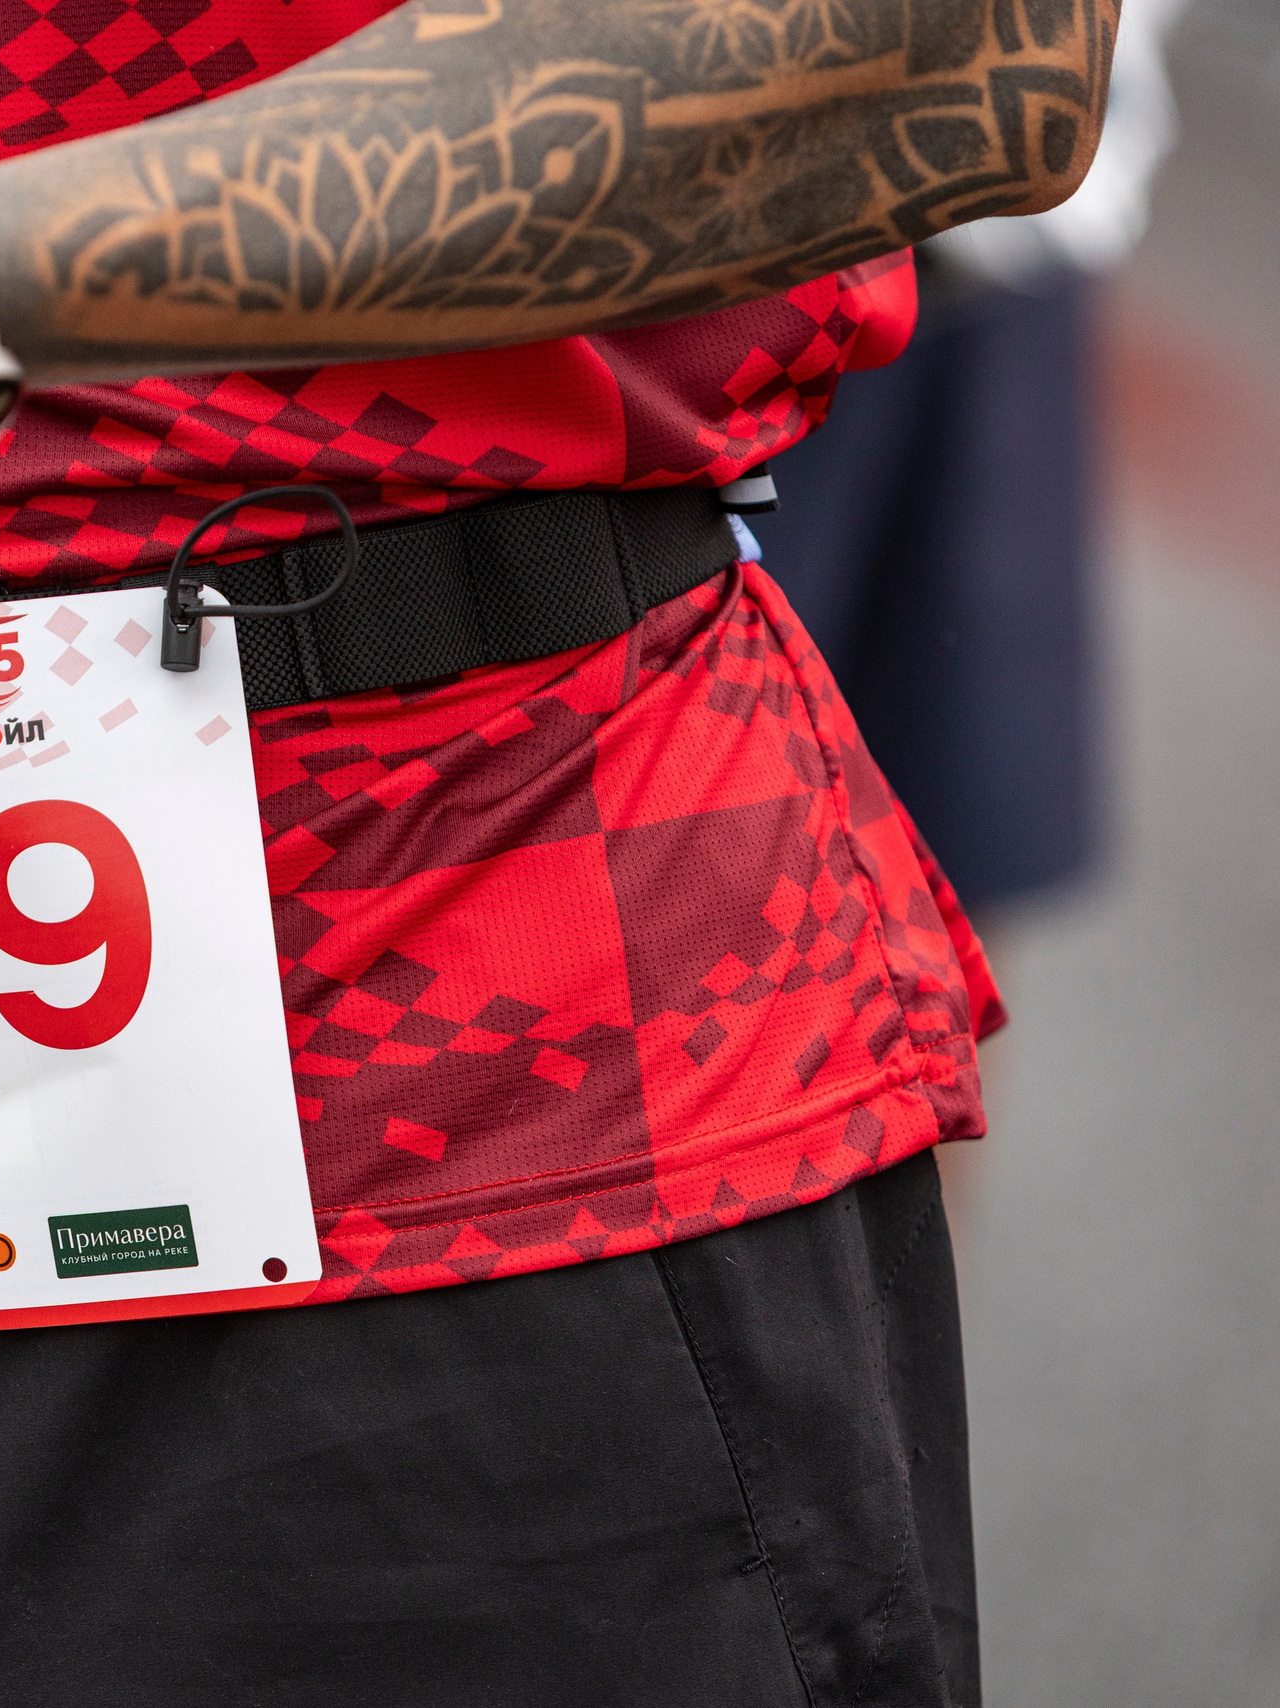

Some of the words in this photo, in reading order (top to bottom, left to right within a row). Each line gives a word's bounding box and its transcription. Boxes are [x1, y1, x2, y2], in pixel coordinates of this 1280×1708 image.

[56, 1224, 186, 1253] Примавера
[61, 1253, 108, 1265] КЛУБНЫЙ
[111, 1250, 145, 1260] ГОРОД
[149, 1249, 161, 1257] НА
[164, 1246, 189, 1255] РЕКЕ
